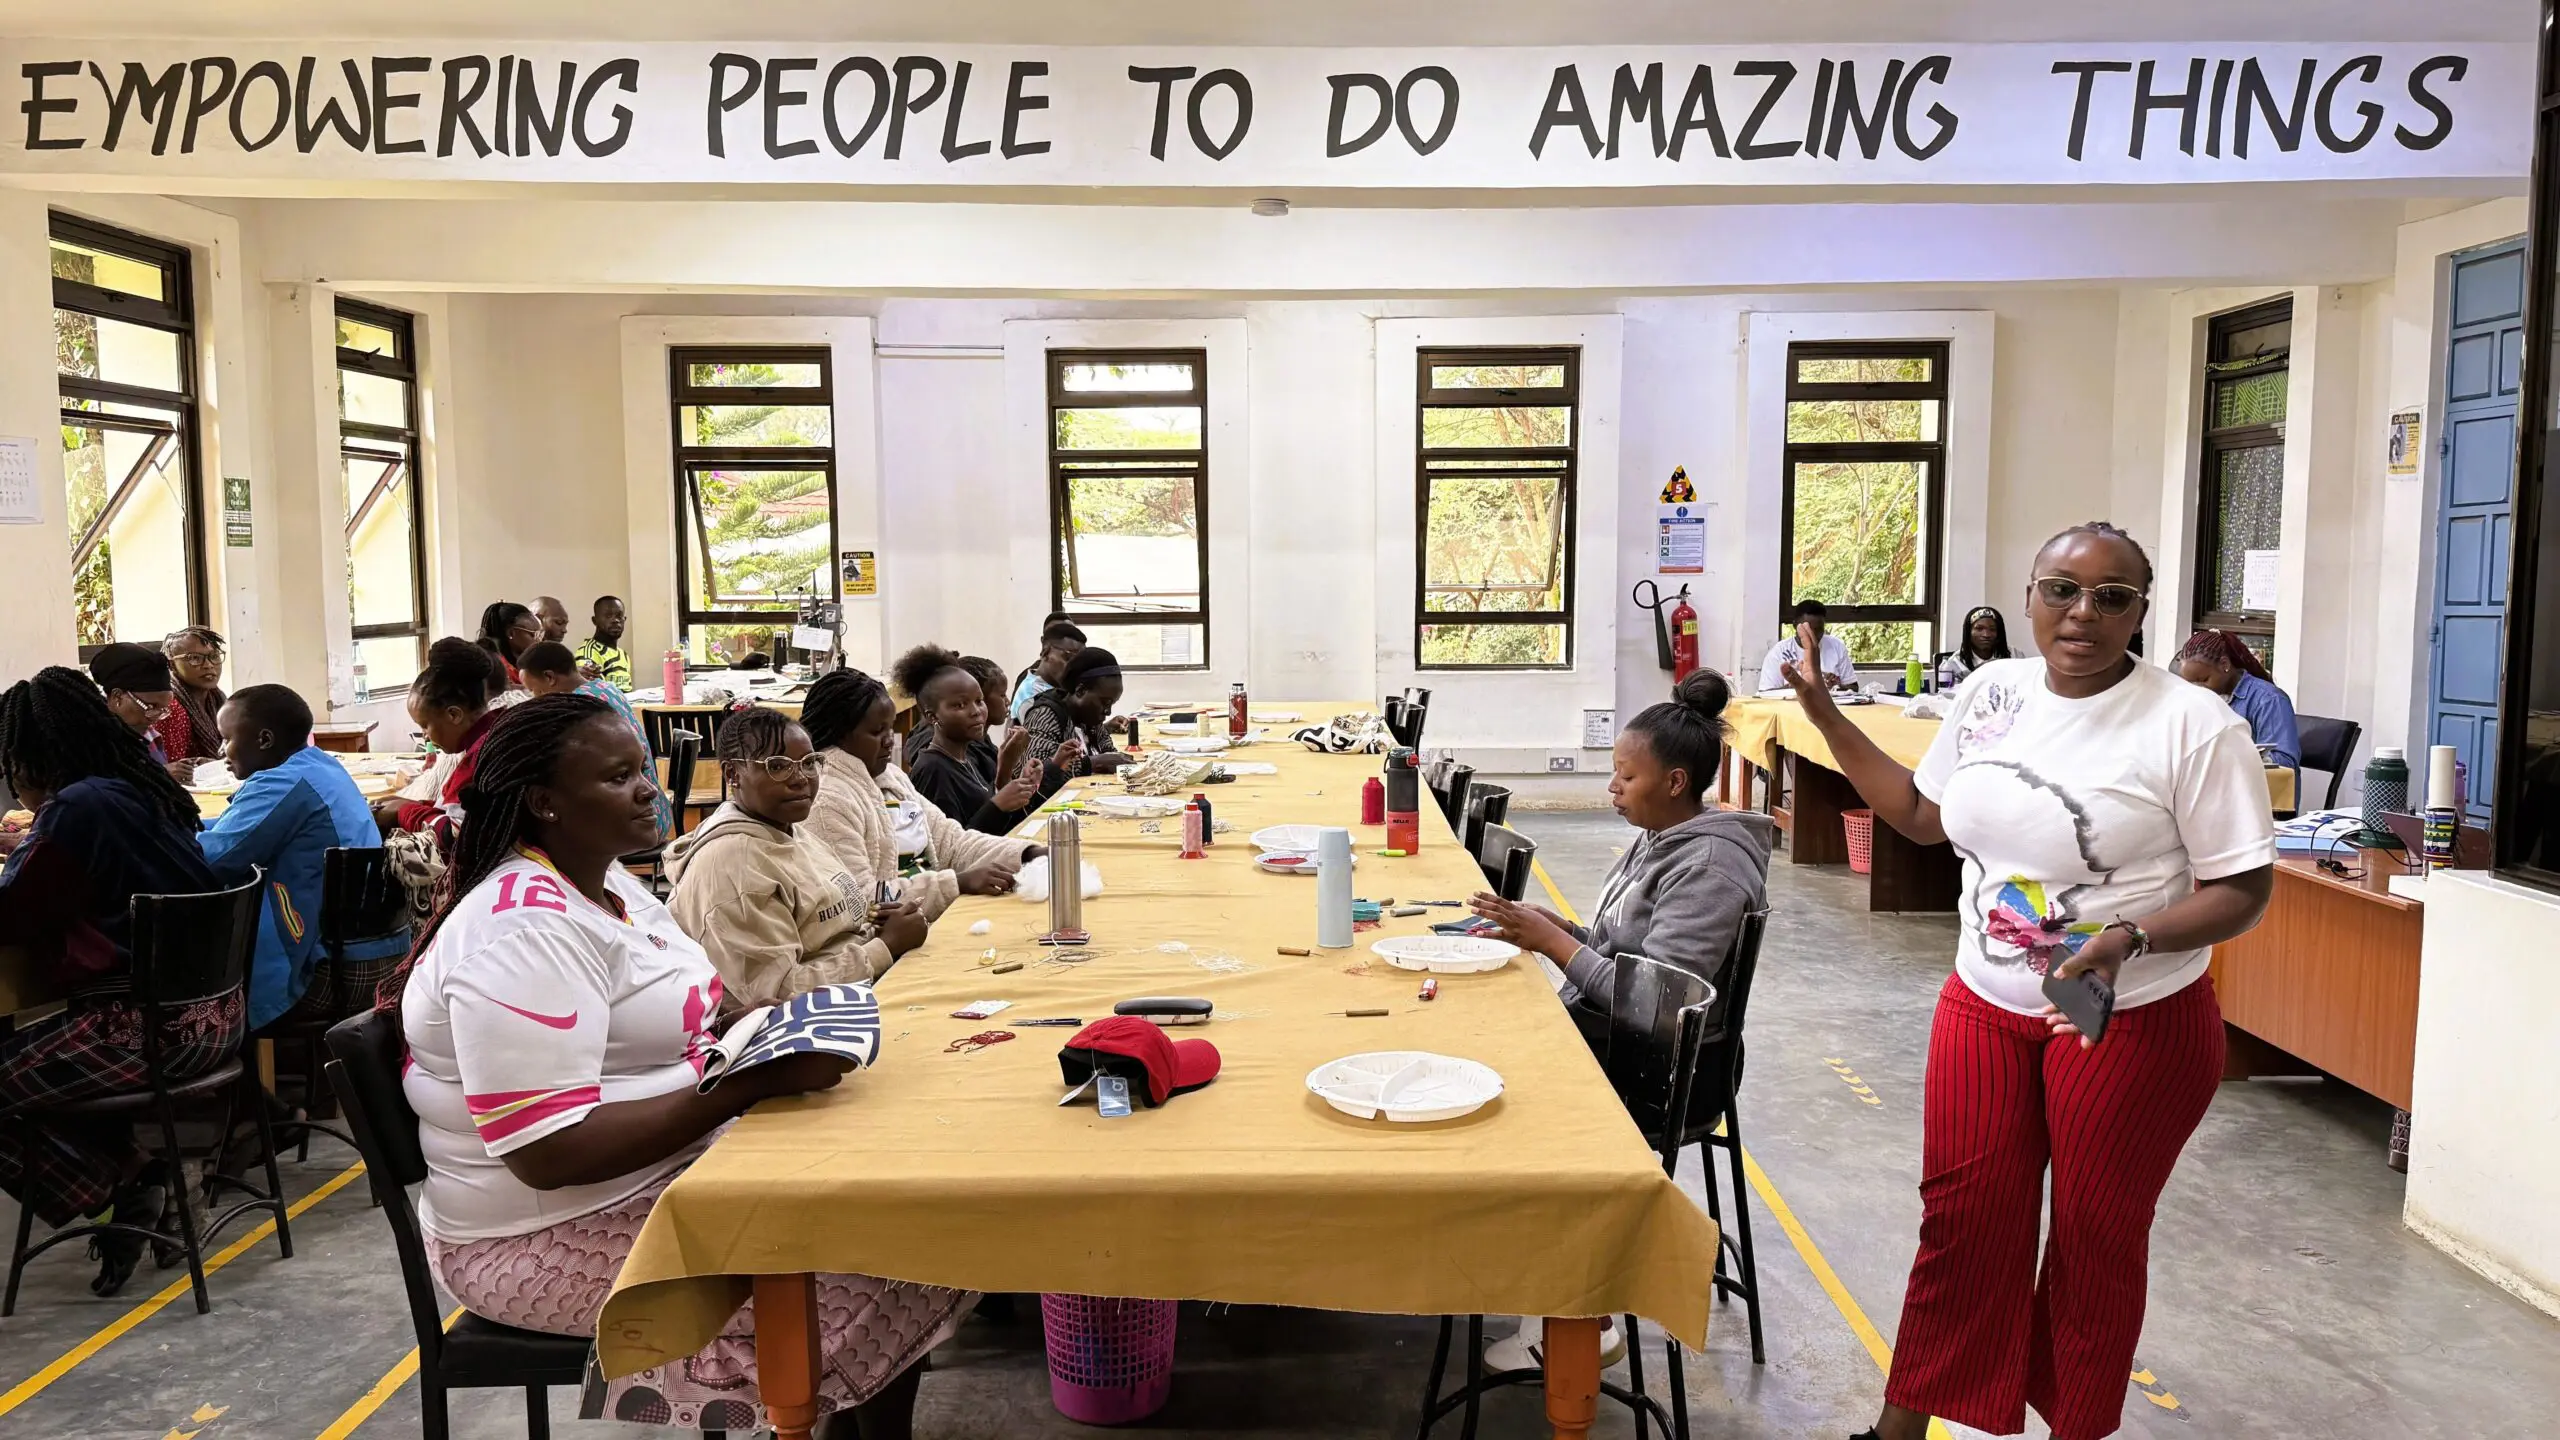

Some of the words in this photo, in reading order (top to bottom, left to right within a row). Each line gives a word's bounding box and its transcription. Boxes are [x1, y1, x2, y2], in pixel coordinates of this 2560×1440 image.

[21, 55, 639, 158] EMPOWERING
[708, 53, 1051, 162] PEOPLE
[1128, 66, 1252, 161] TO
[1327, 66, 1459, 157] DO
[1529, 56, 1958, 161] AMAZING
[2052, 56, 2468, 161] THINGS
[491, 872, 567, 915] 12
